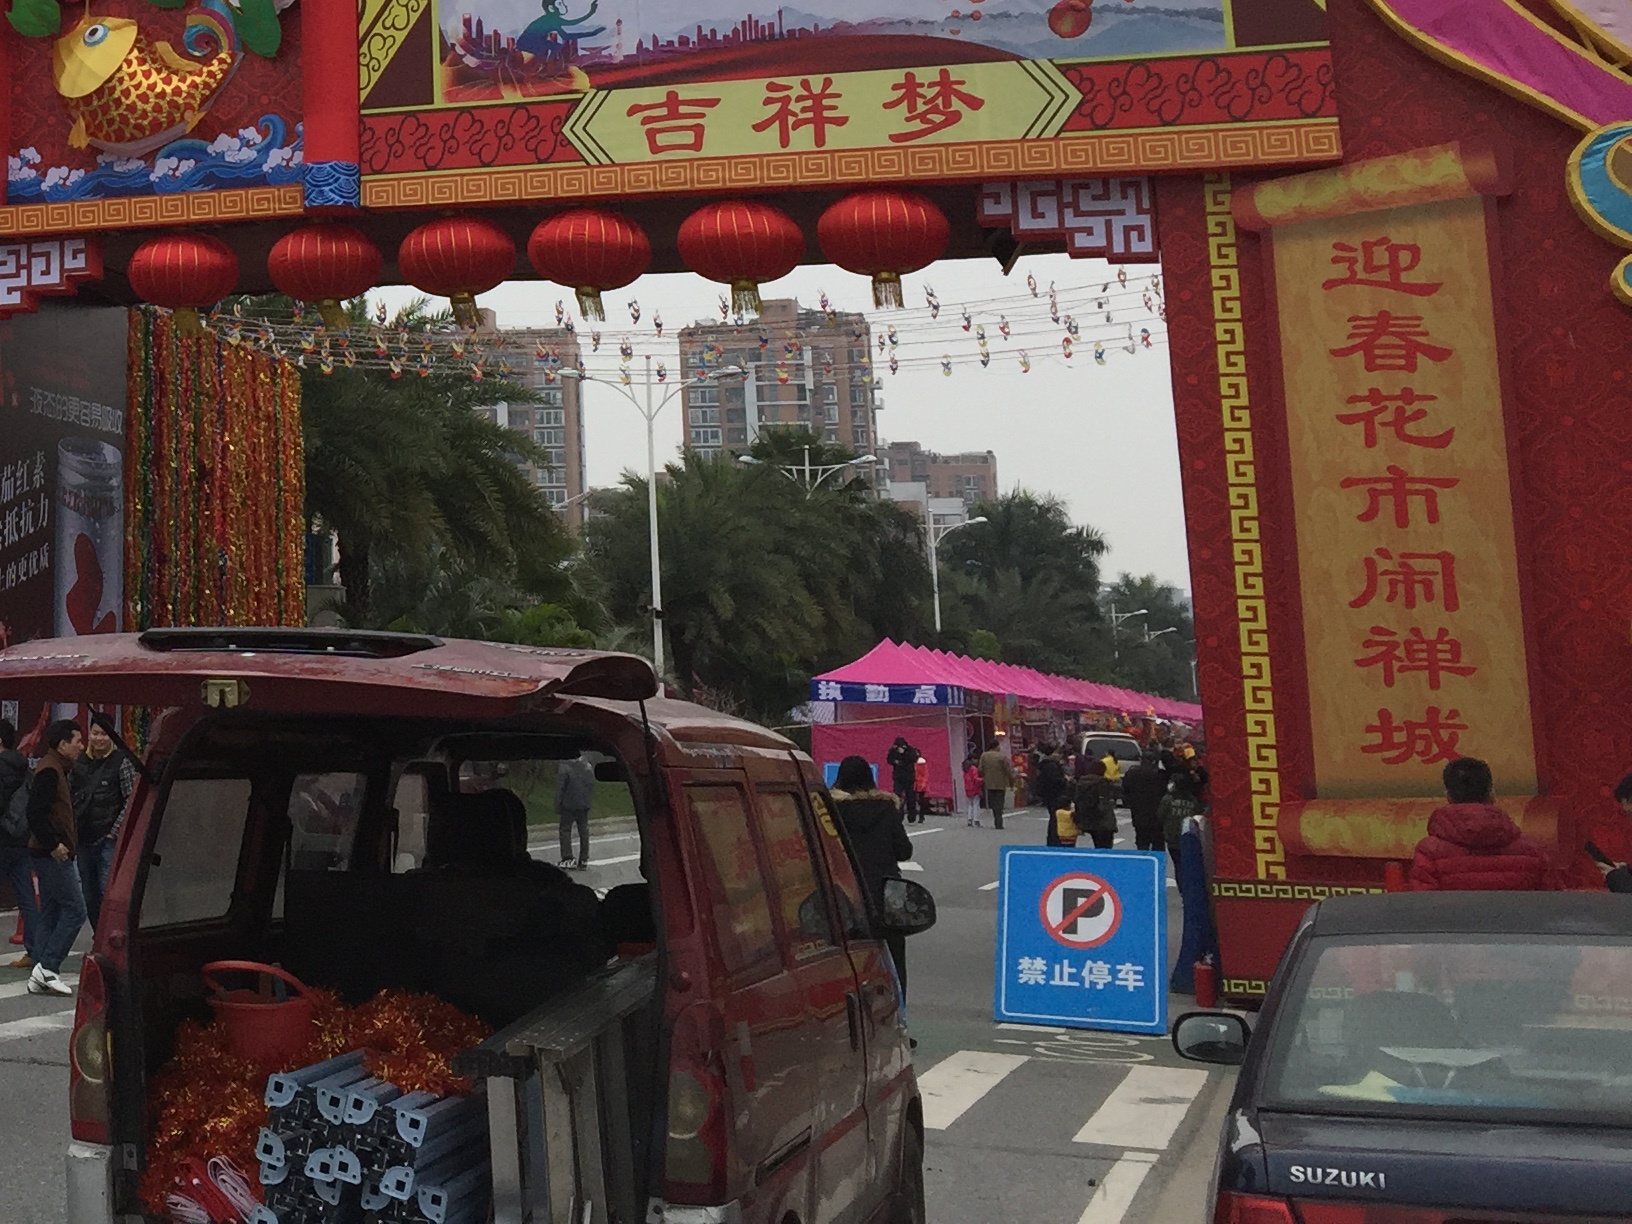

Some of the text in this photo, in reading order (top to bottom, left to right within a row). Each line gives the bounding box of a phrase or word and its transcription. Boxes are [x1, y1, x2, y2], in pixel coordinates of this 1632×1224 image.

[627, 69, 986, 157] 吉祥梦
[1322, 237, 1477, 766] 迎春花市闹禅城
[818, 681, 938, 704] 执勤点
[1017, 954, 1145, 993] 禁止停车
[1289, 1164, 1387, 1189] SUZUKI
